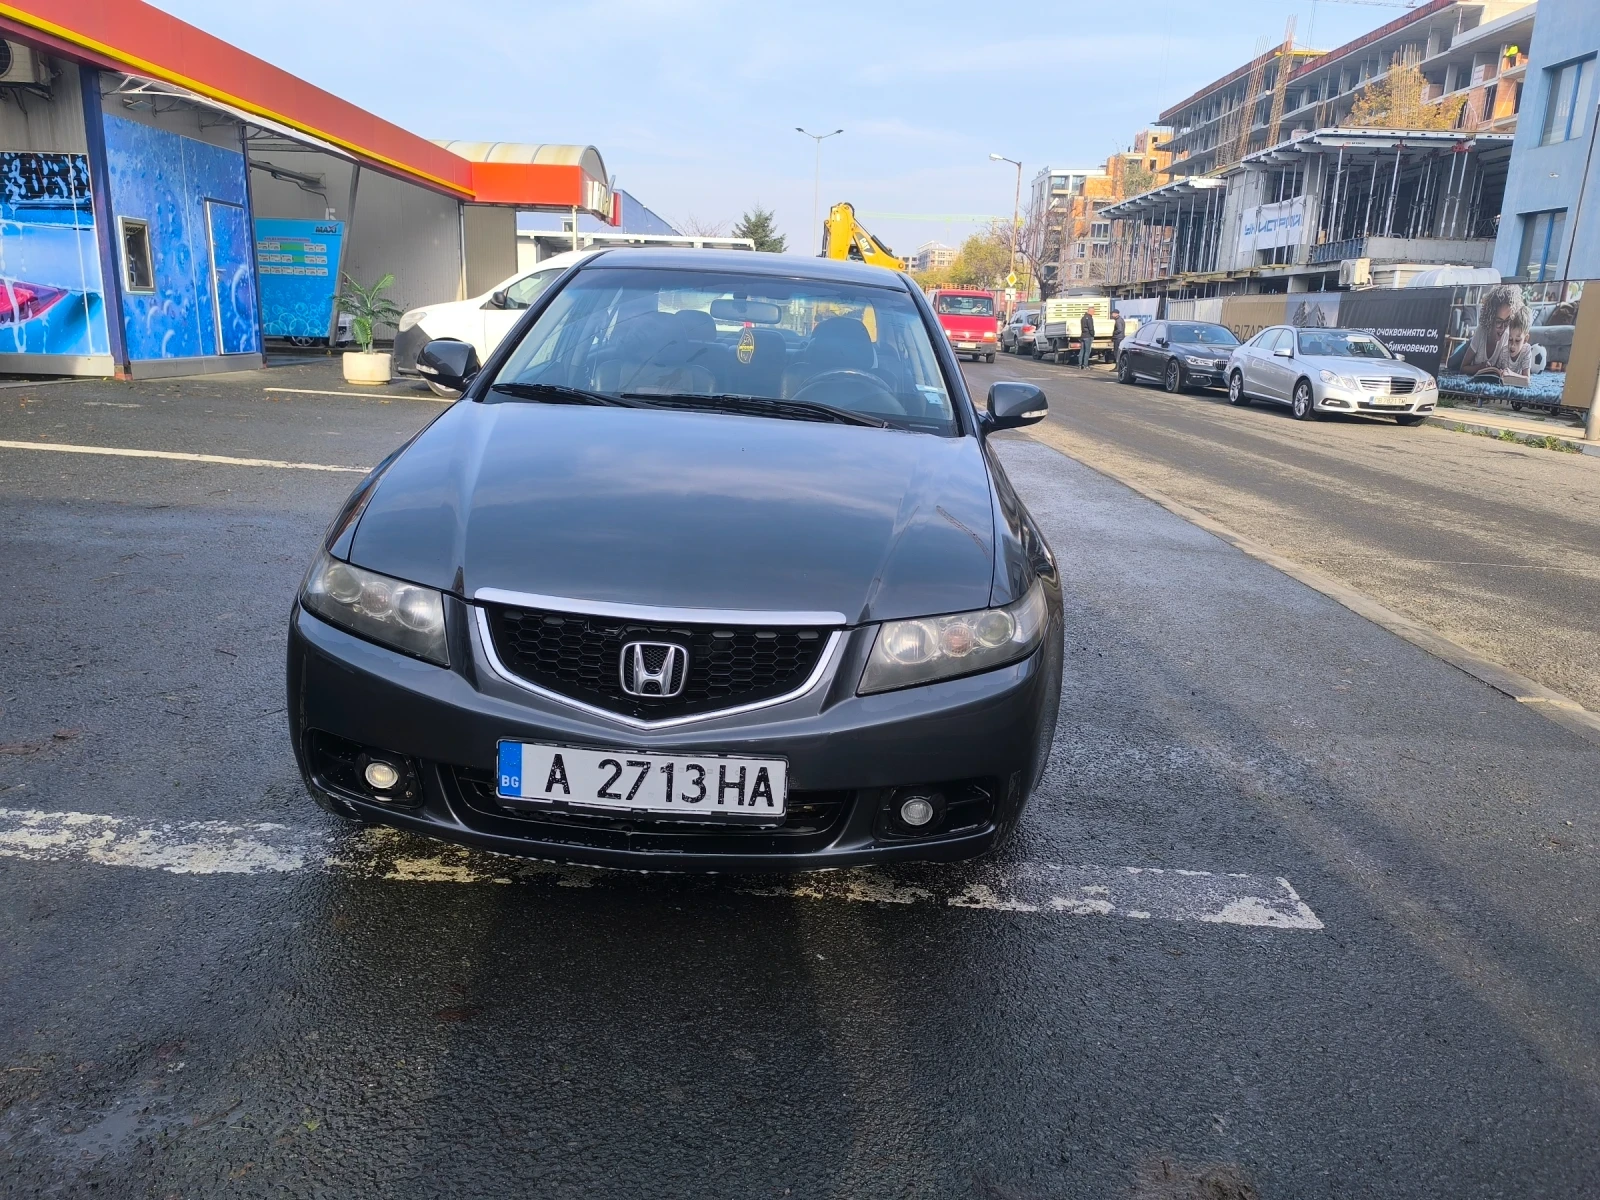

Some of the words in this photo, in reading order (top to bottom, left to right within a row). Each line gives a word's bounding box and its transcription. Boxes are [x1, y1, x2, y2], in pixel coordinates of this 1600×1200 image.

[1376, 328, 1425, 337] очакванията
[1426, 328, 1439, 339] си,
[501, 774, 520, 788] BG
[545, 753, 571, 795] A
